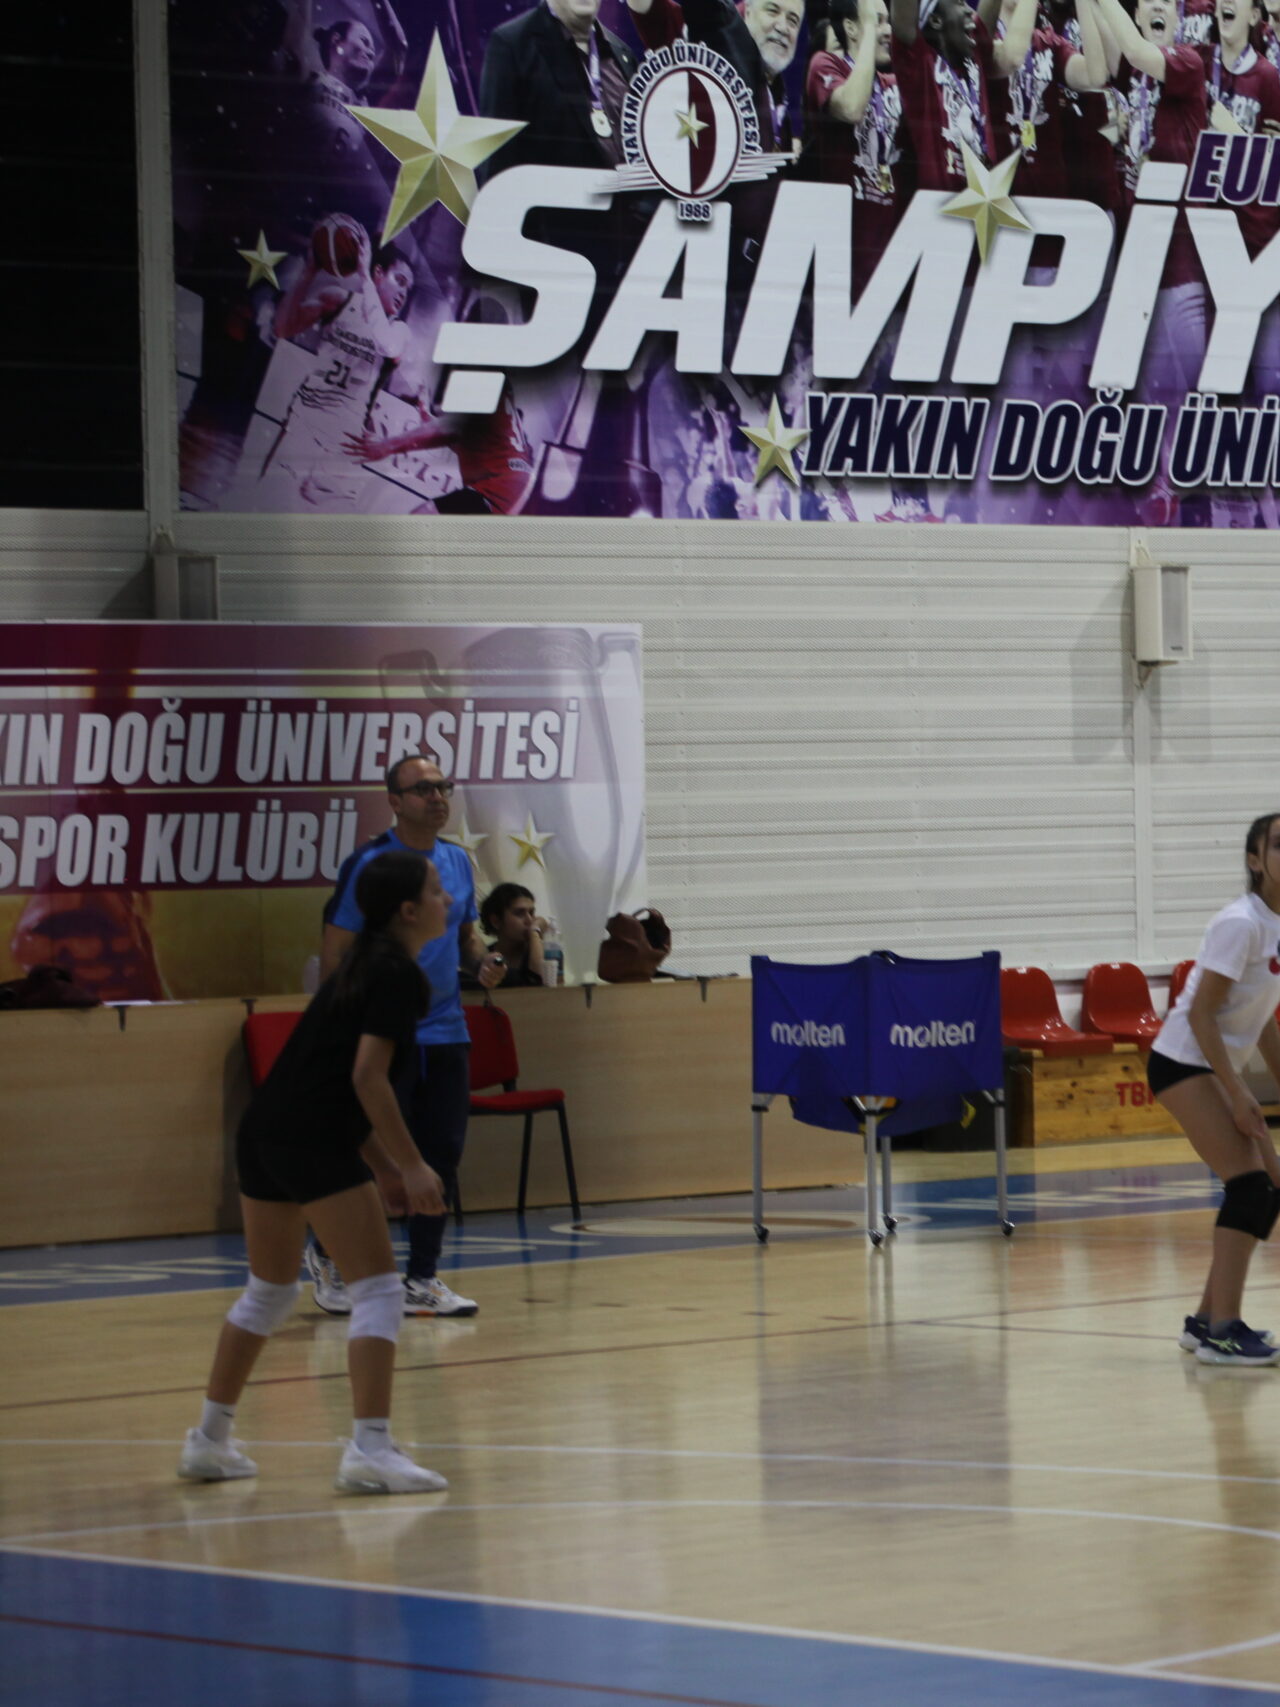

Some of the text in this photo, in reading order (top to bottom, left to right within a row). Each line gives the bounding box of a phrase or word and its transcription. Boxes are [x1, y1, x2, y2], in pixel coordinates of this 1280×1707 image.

[632, 49, 672, 95] DOĞU
[623, 95, 642, 165] YAKIN
[680, 202, 710, 218] 1988
[801, 392, 989, 479] YAKIN
[989, 387, 1167, 486] DOĞU
[0, 697, 580, 785] IN DOĞU ÜNİVERSİTESİ
[140, 798, 358, 884] KULÜBÜ
[770, 1019, 845, 1048] molten
[889, 1019, 976, 1048] molten
